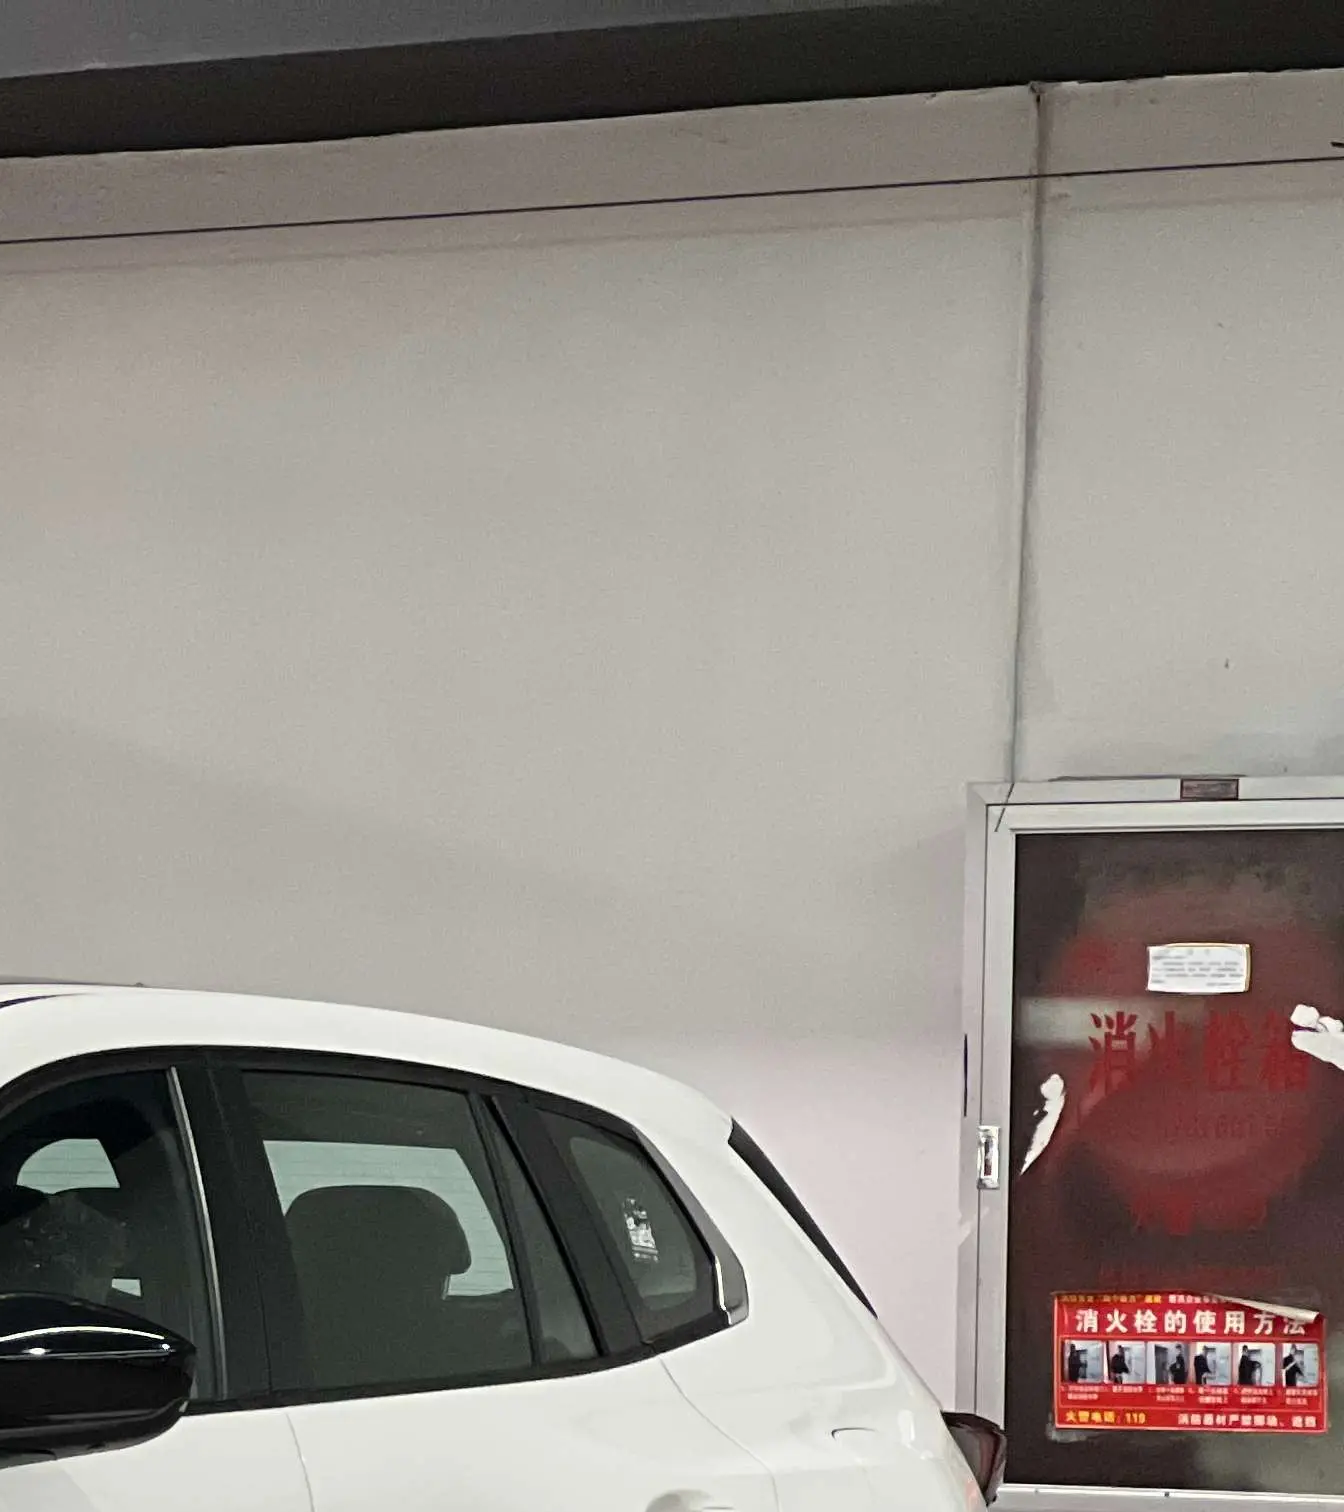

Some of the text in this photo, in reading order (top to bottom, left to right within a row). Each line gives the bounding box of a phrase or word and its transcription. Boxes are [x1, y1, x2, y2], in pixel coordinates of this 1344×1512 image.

[1075, 1307, 1307, 1336] 消火栓的使用方法
